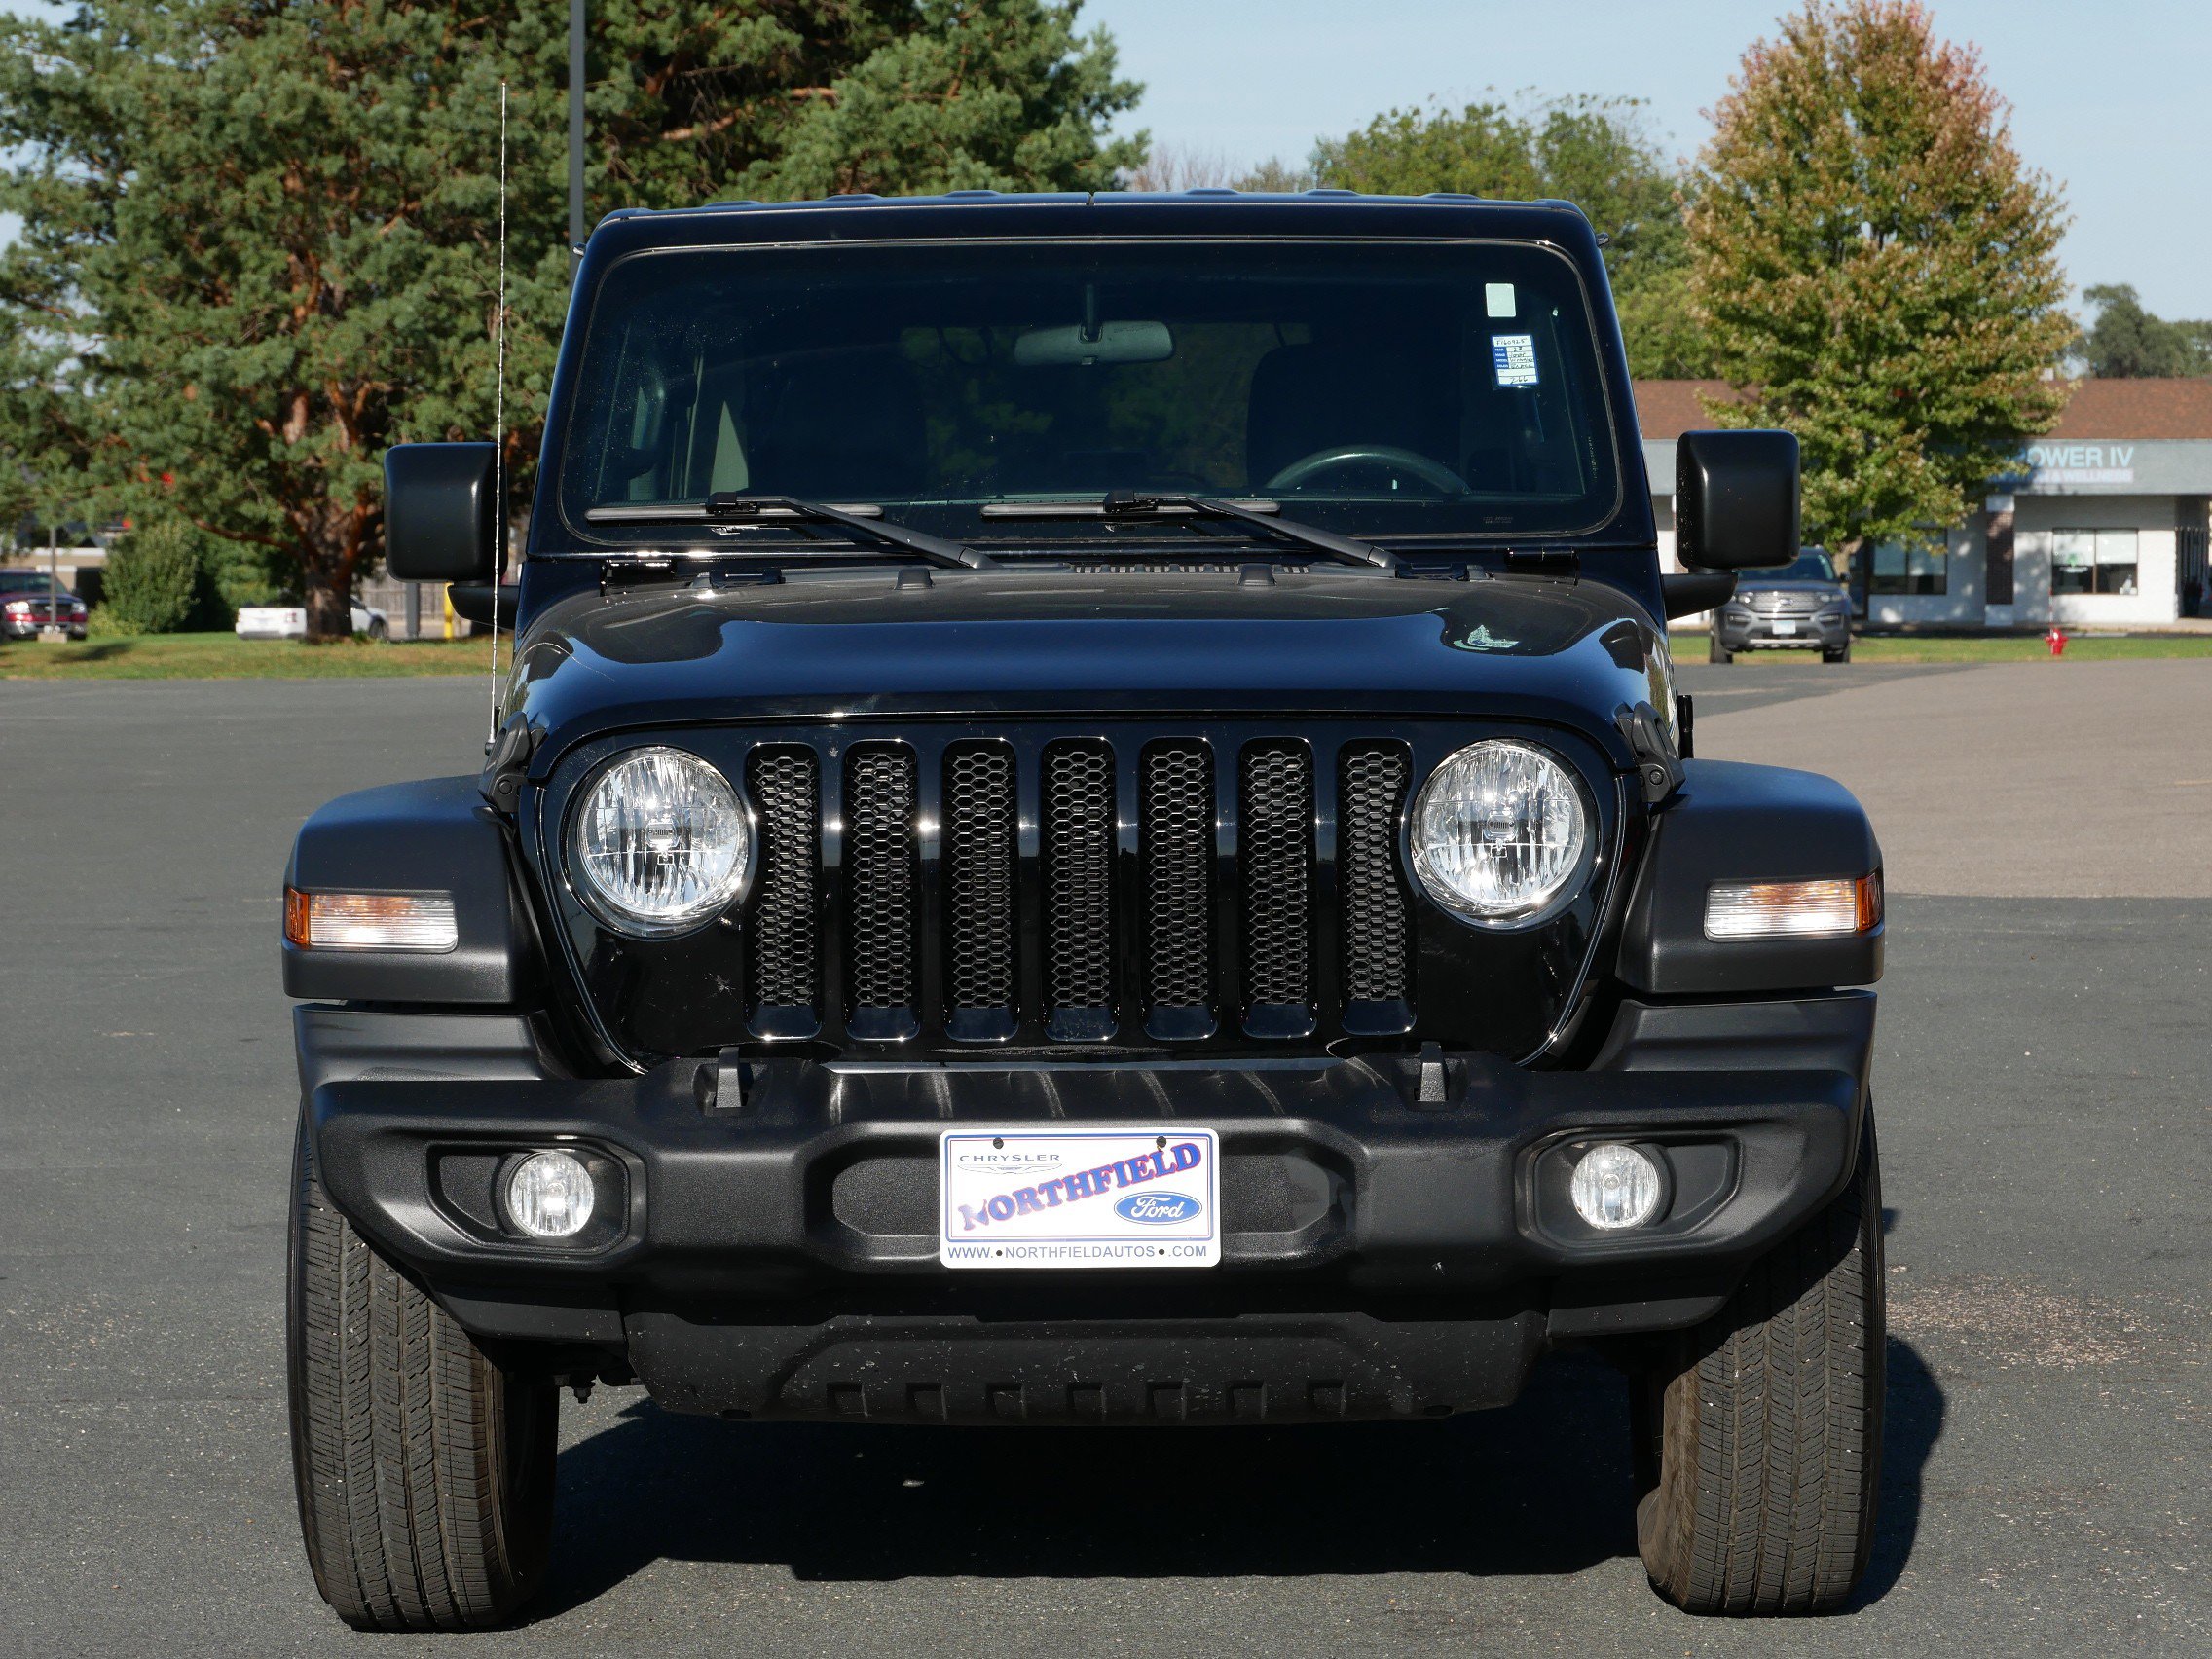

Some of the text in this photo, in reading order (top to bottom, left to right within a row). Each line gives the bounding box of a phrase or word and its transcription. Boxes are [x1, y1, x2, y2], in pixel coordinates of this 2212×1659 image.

[2110, 446, 2134, 467] IV
[959, 1154, 1060, 1162] CHRYSLER
[958, 1142, 1202, 1232] NORTHFIELD
[1130, 1196, 1184, 1219] Ford
